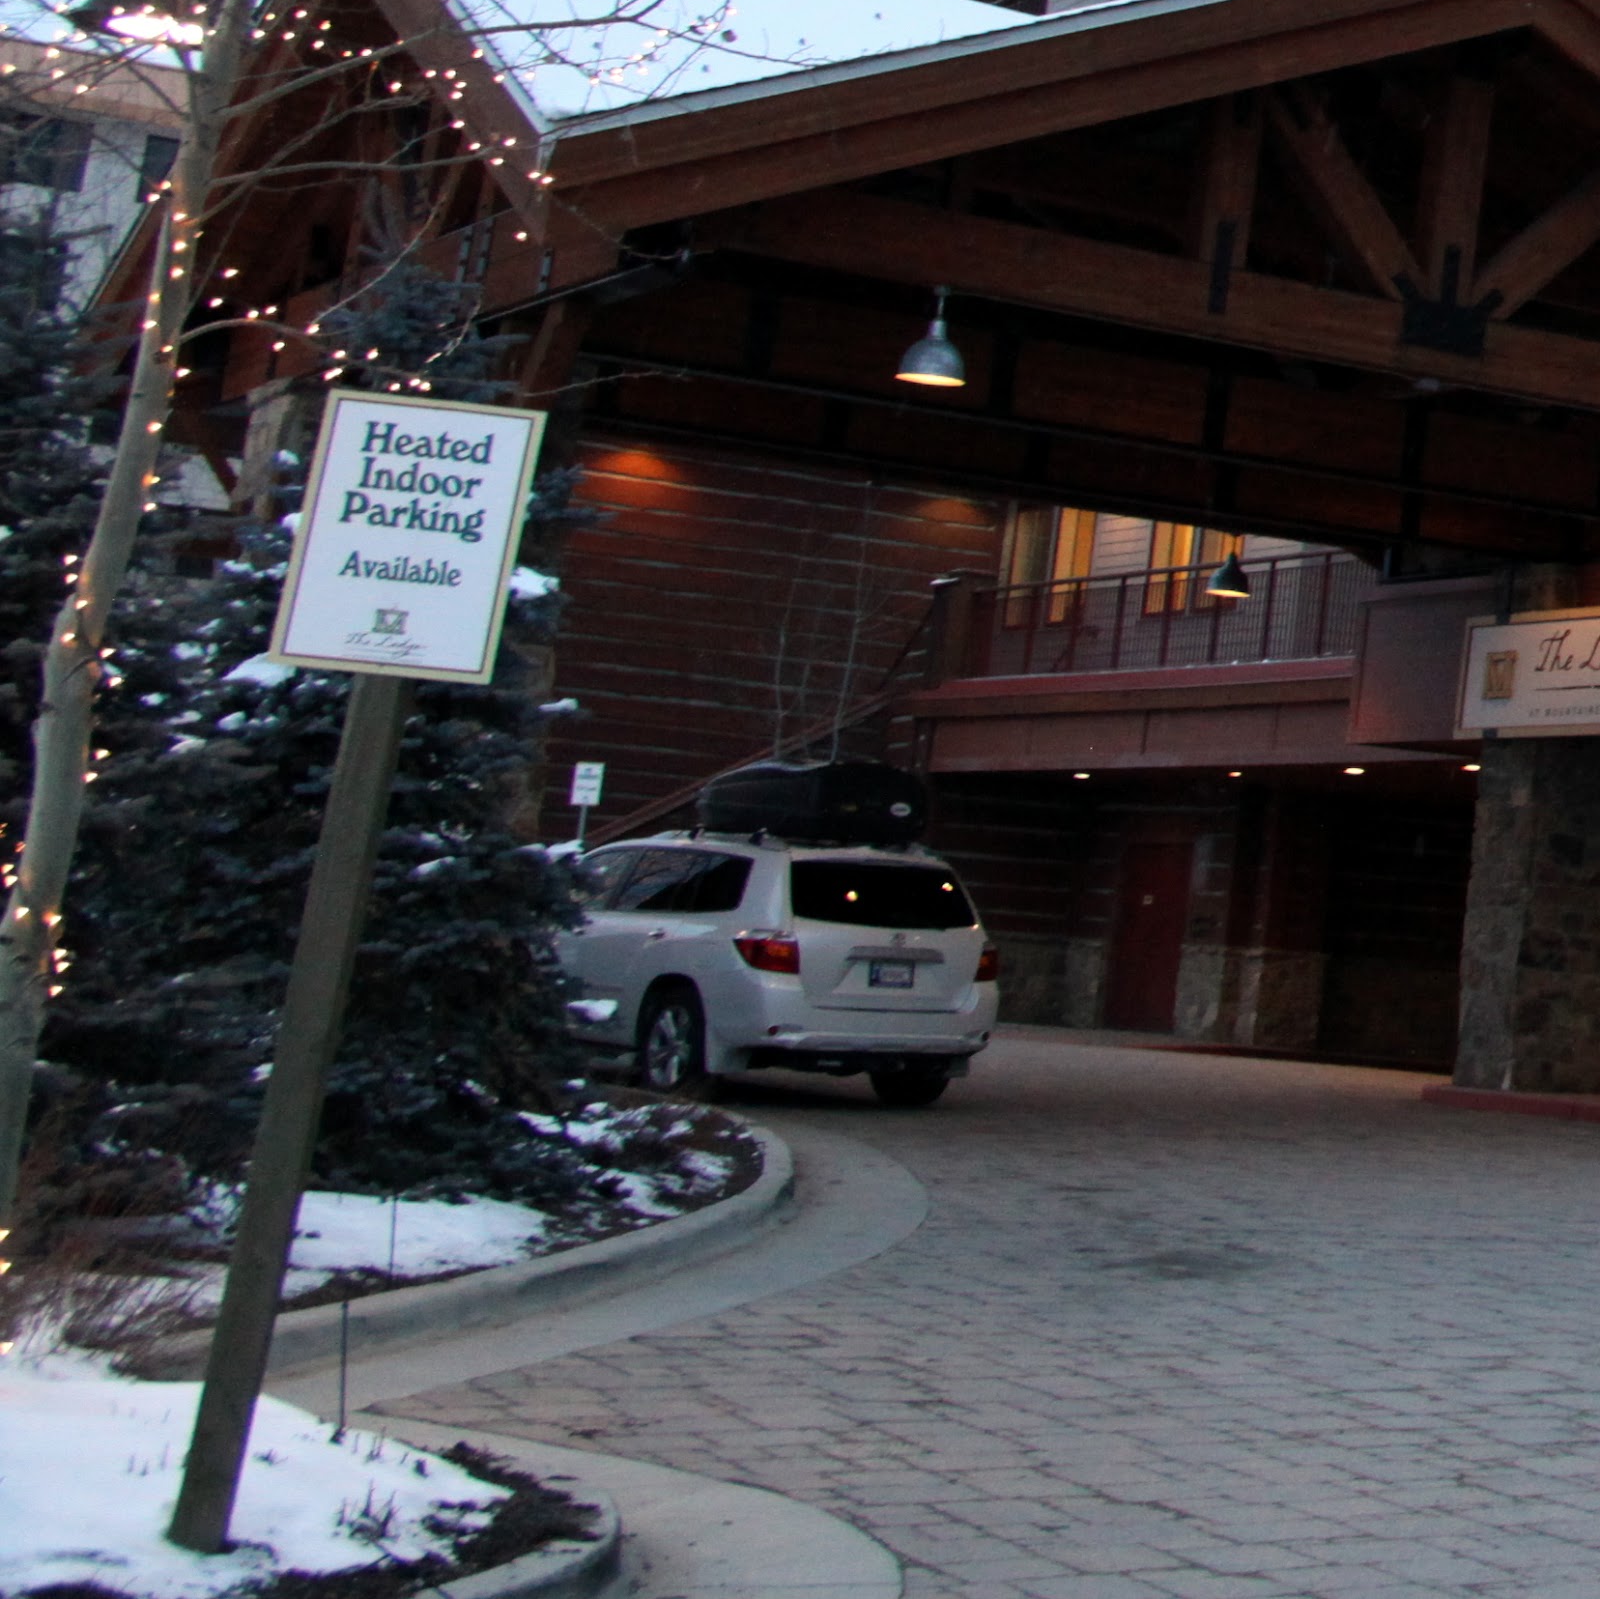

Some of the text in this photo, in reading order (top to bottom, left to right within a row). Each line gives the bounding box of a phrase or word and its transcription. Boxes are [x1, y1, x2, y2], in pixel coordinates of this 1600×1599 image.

[361, 420, 495, 465] Heated
[358, 456, 483, 499] Indoor
[338, 491, 487, 543] Parking
[338, 550, 462, 587] Available
[1534, 628, 1574, 672] The
